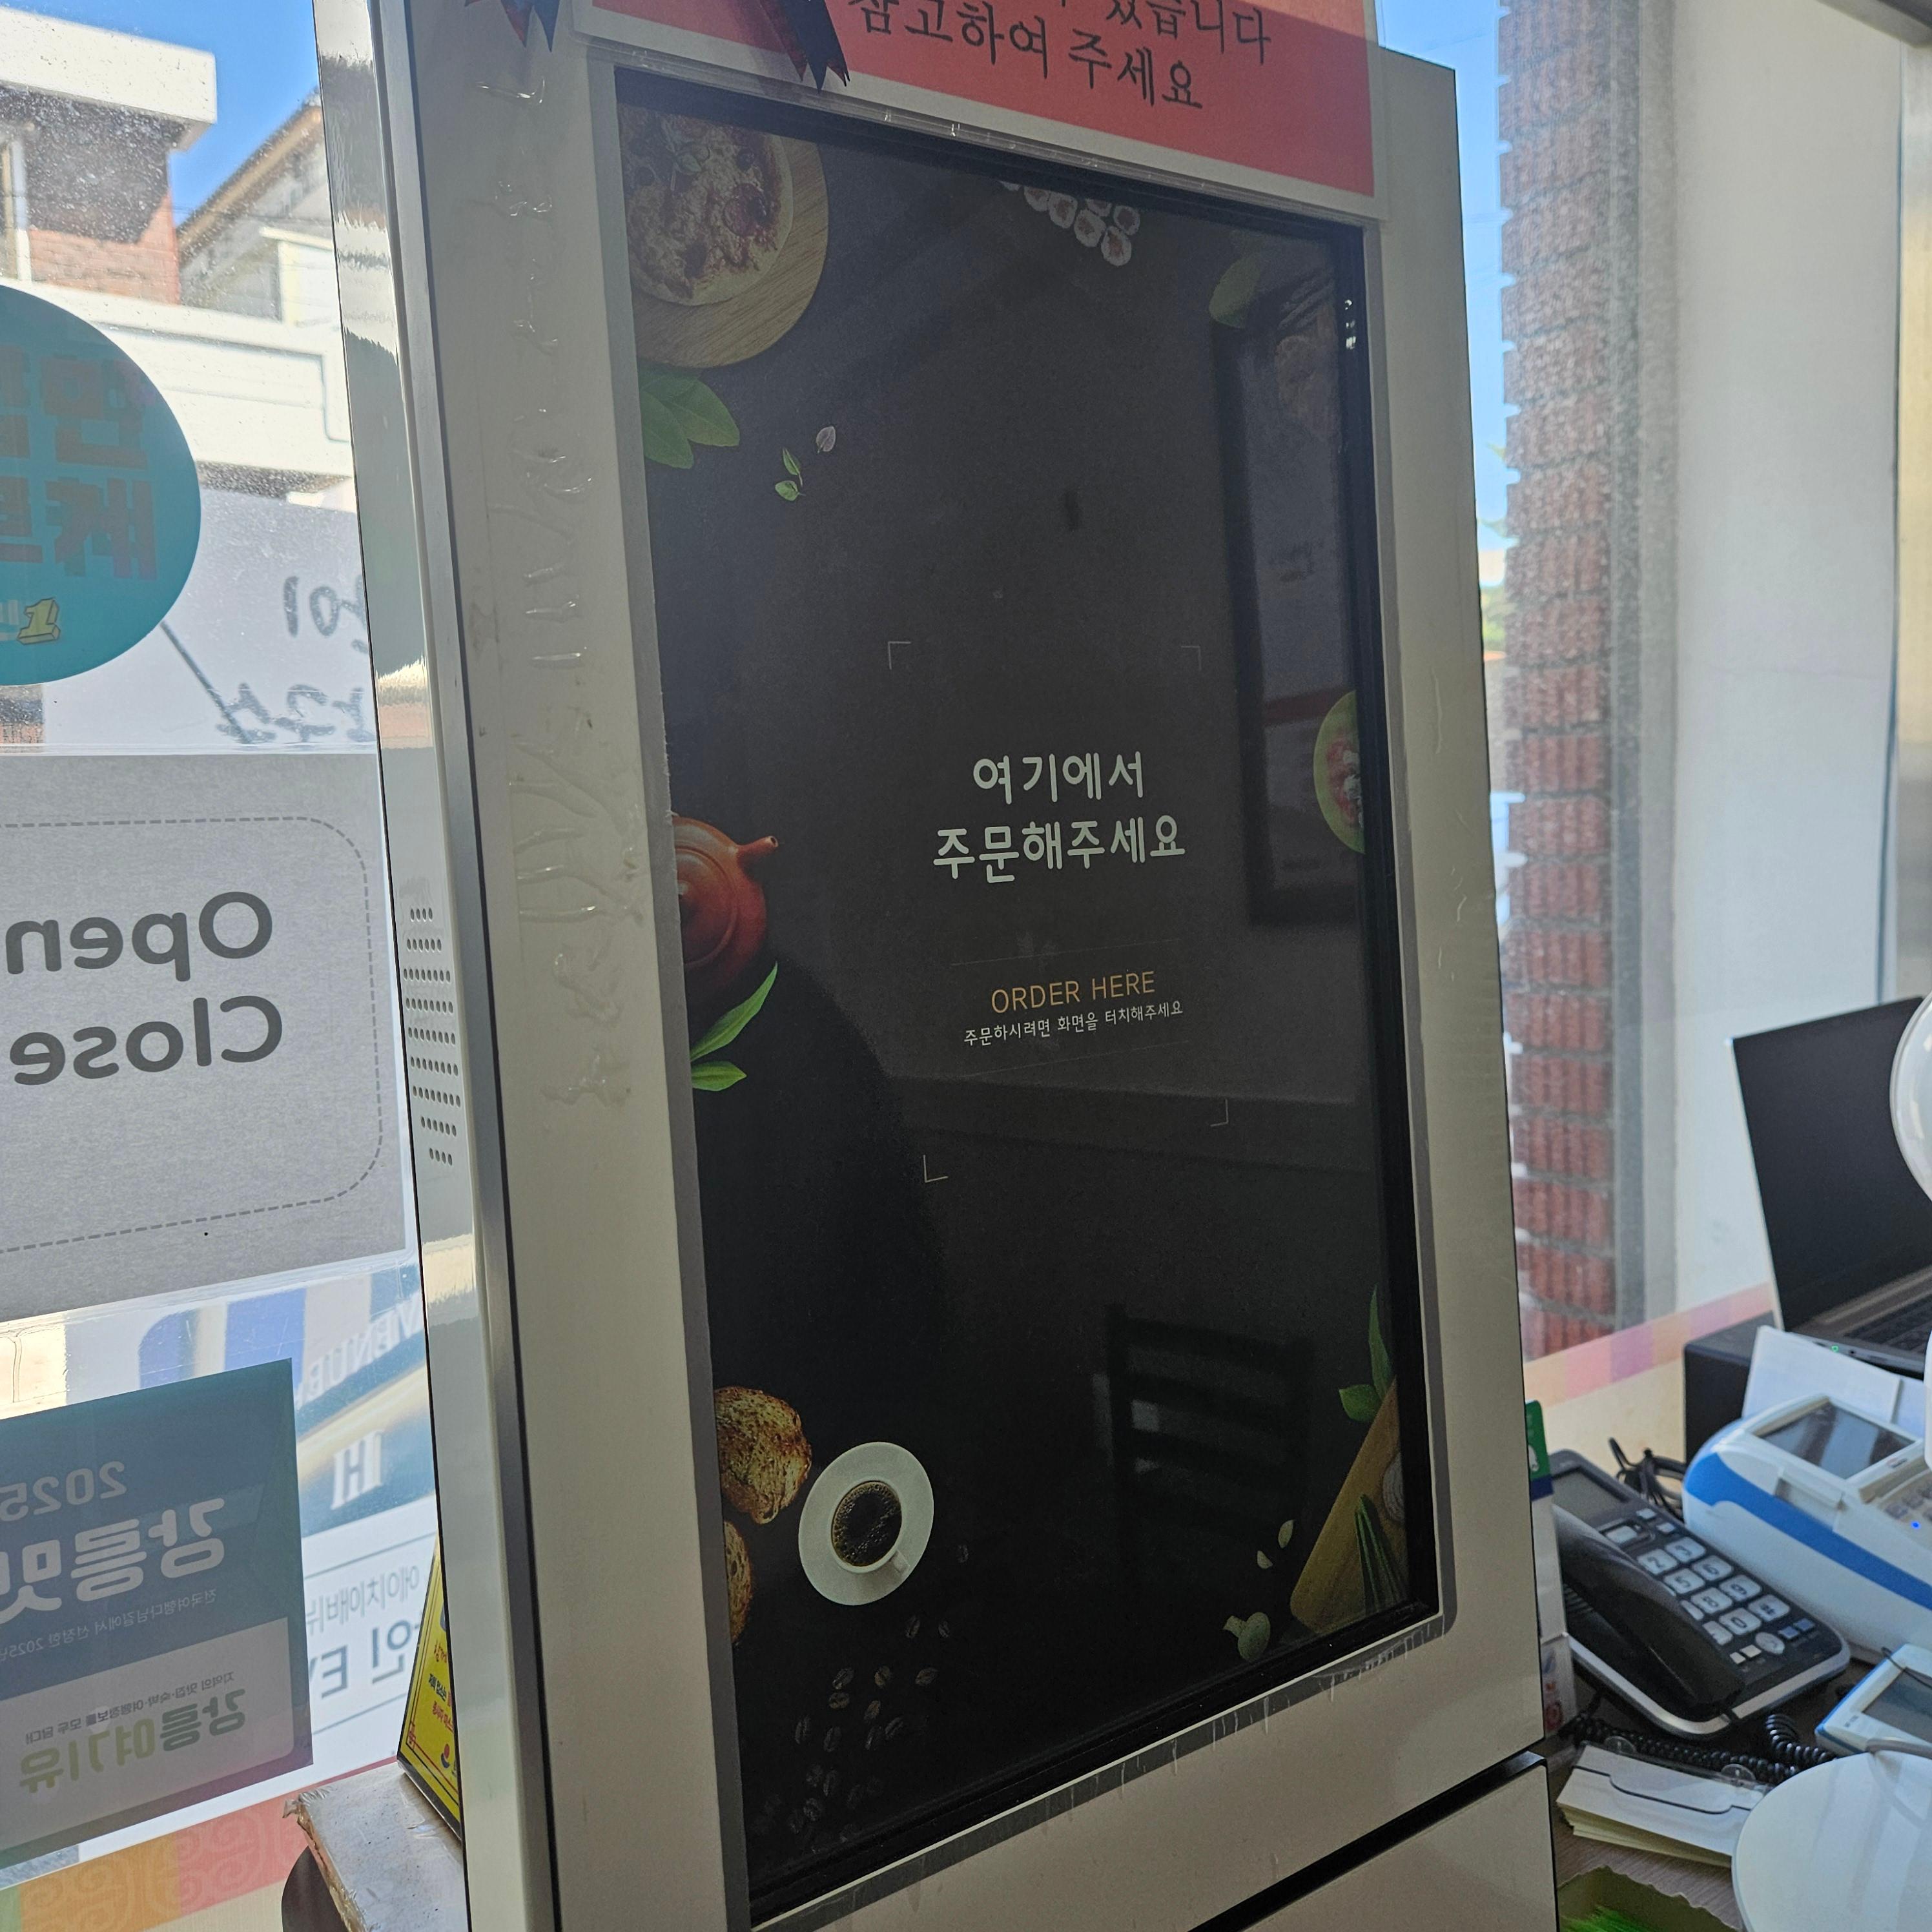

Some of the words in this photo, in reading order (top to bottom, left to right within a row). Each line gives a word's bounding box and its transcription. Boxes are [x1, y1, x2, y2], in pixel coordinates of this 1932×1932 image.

[1069, 28, 1202, 108] 주세요
[973, 751, 1144, 805] 여기에서
[933, 815, 1186, 883] 주문해주세요
[992, 980, 1081, 1013] ORDER
[1091, 971, 1156, 1000] HERE
[964, 1018, 1051, 1046] 주문하시려면
[1057, 1012, 1098, 1033] 화면을
[1105, 1000, 1183, 1025] 터치해주세요
